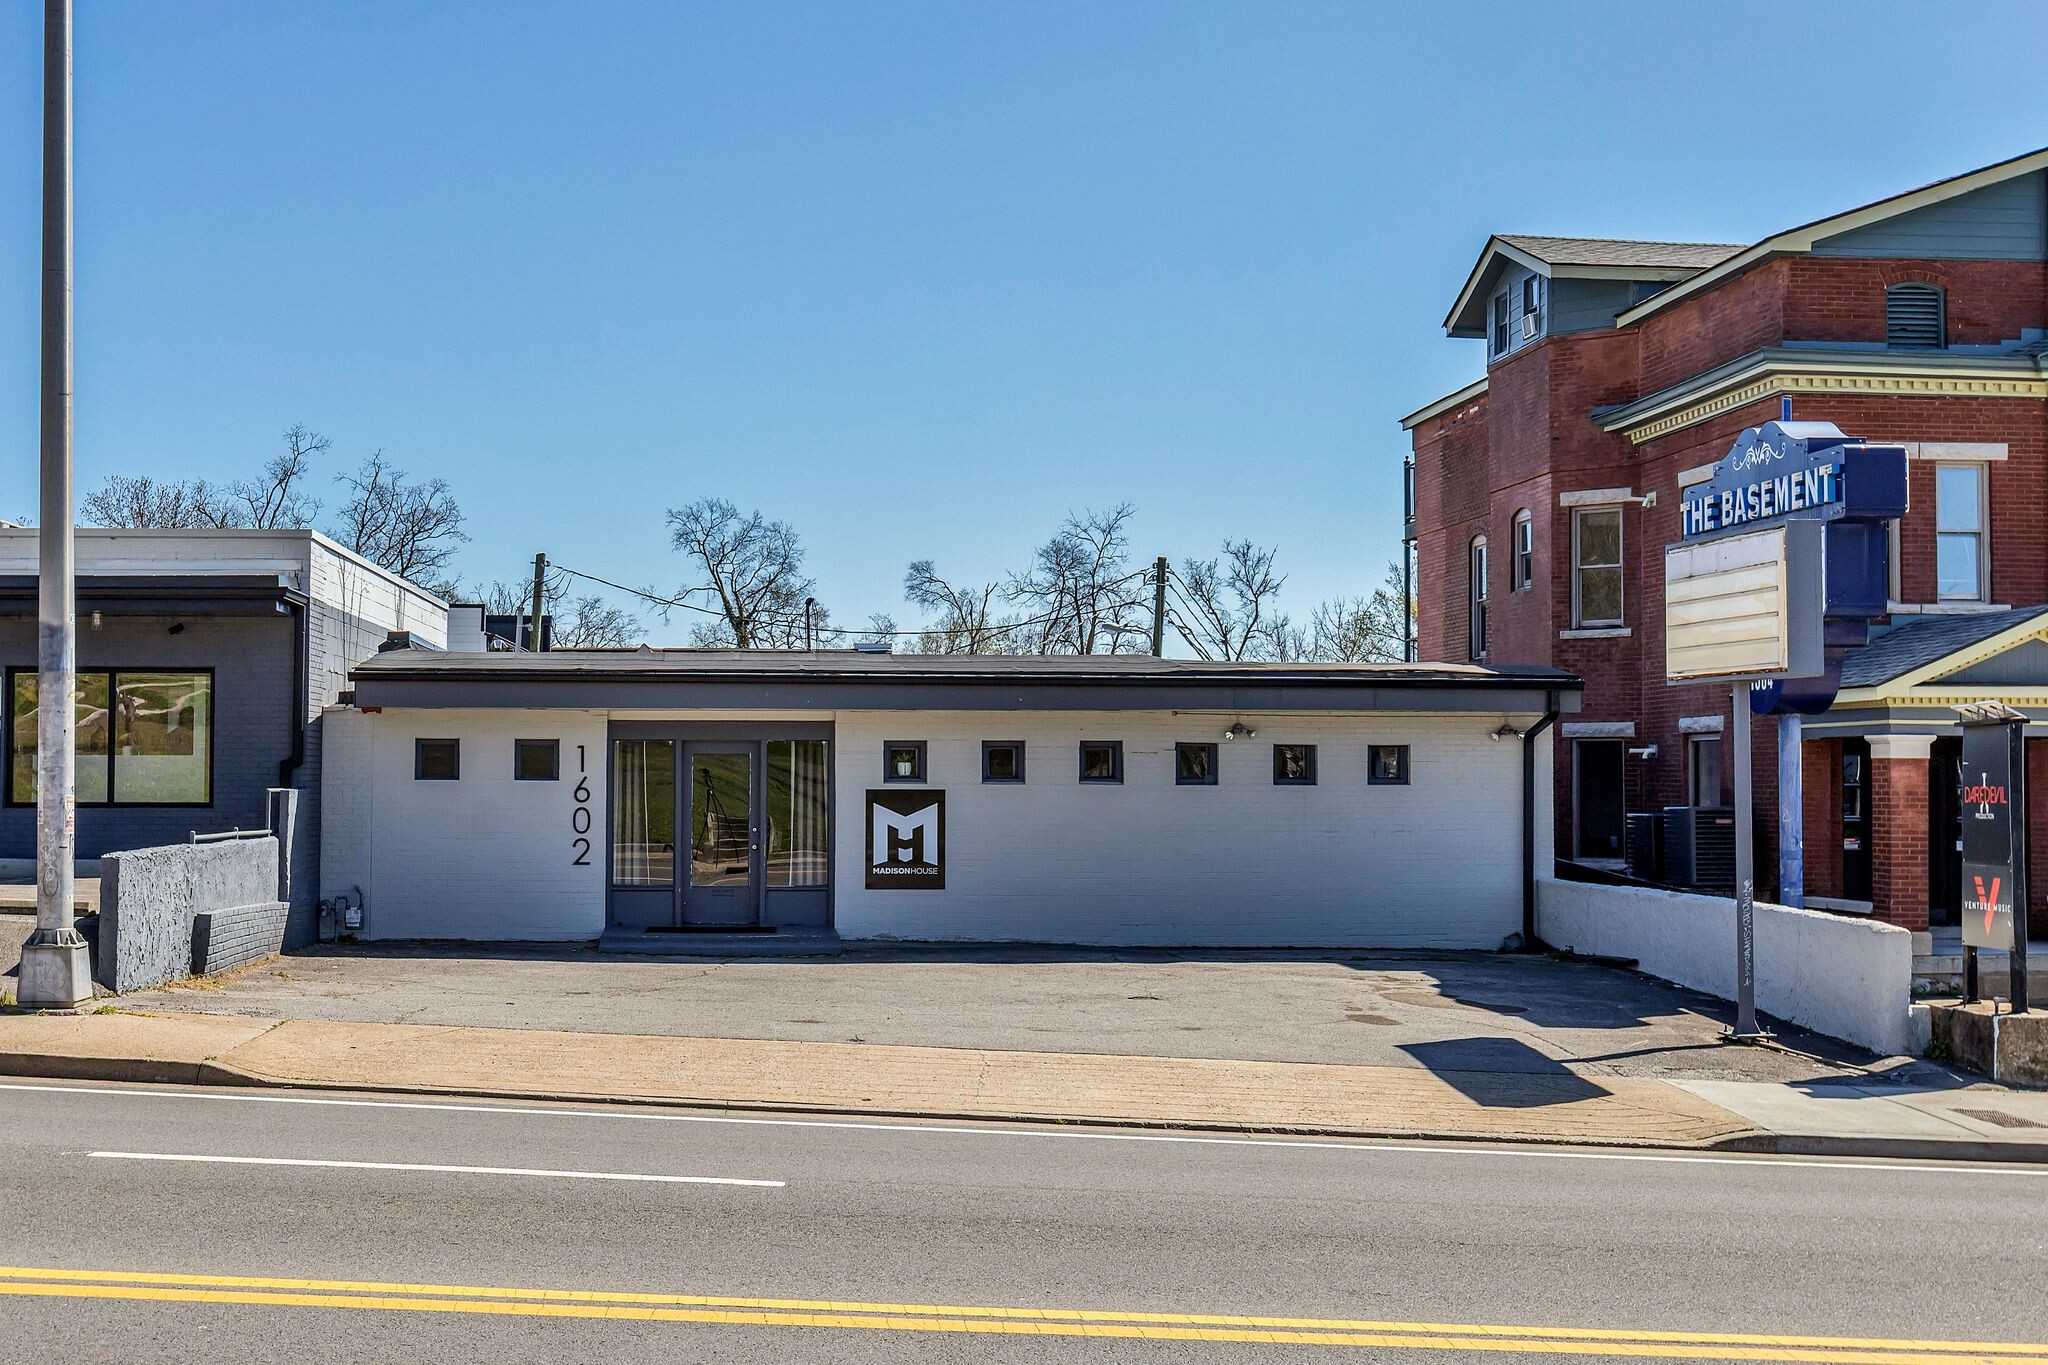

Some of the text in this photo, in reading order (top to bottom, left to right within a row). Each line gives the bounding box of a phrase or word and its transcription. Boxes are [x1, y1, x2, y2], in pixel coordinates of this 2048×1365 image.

[1680, 463, 1836, 536] THE BASEMENT
[1964, 785, 2007, 804] DAREDEVIL
[572, 744, 591, 866] 1602
[872, 867, 939, 875] MADISONHOUSE
[1964, 900, 2011, 913] VENTURE MUSIC
